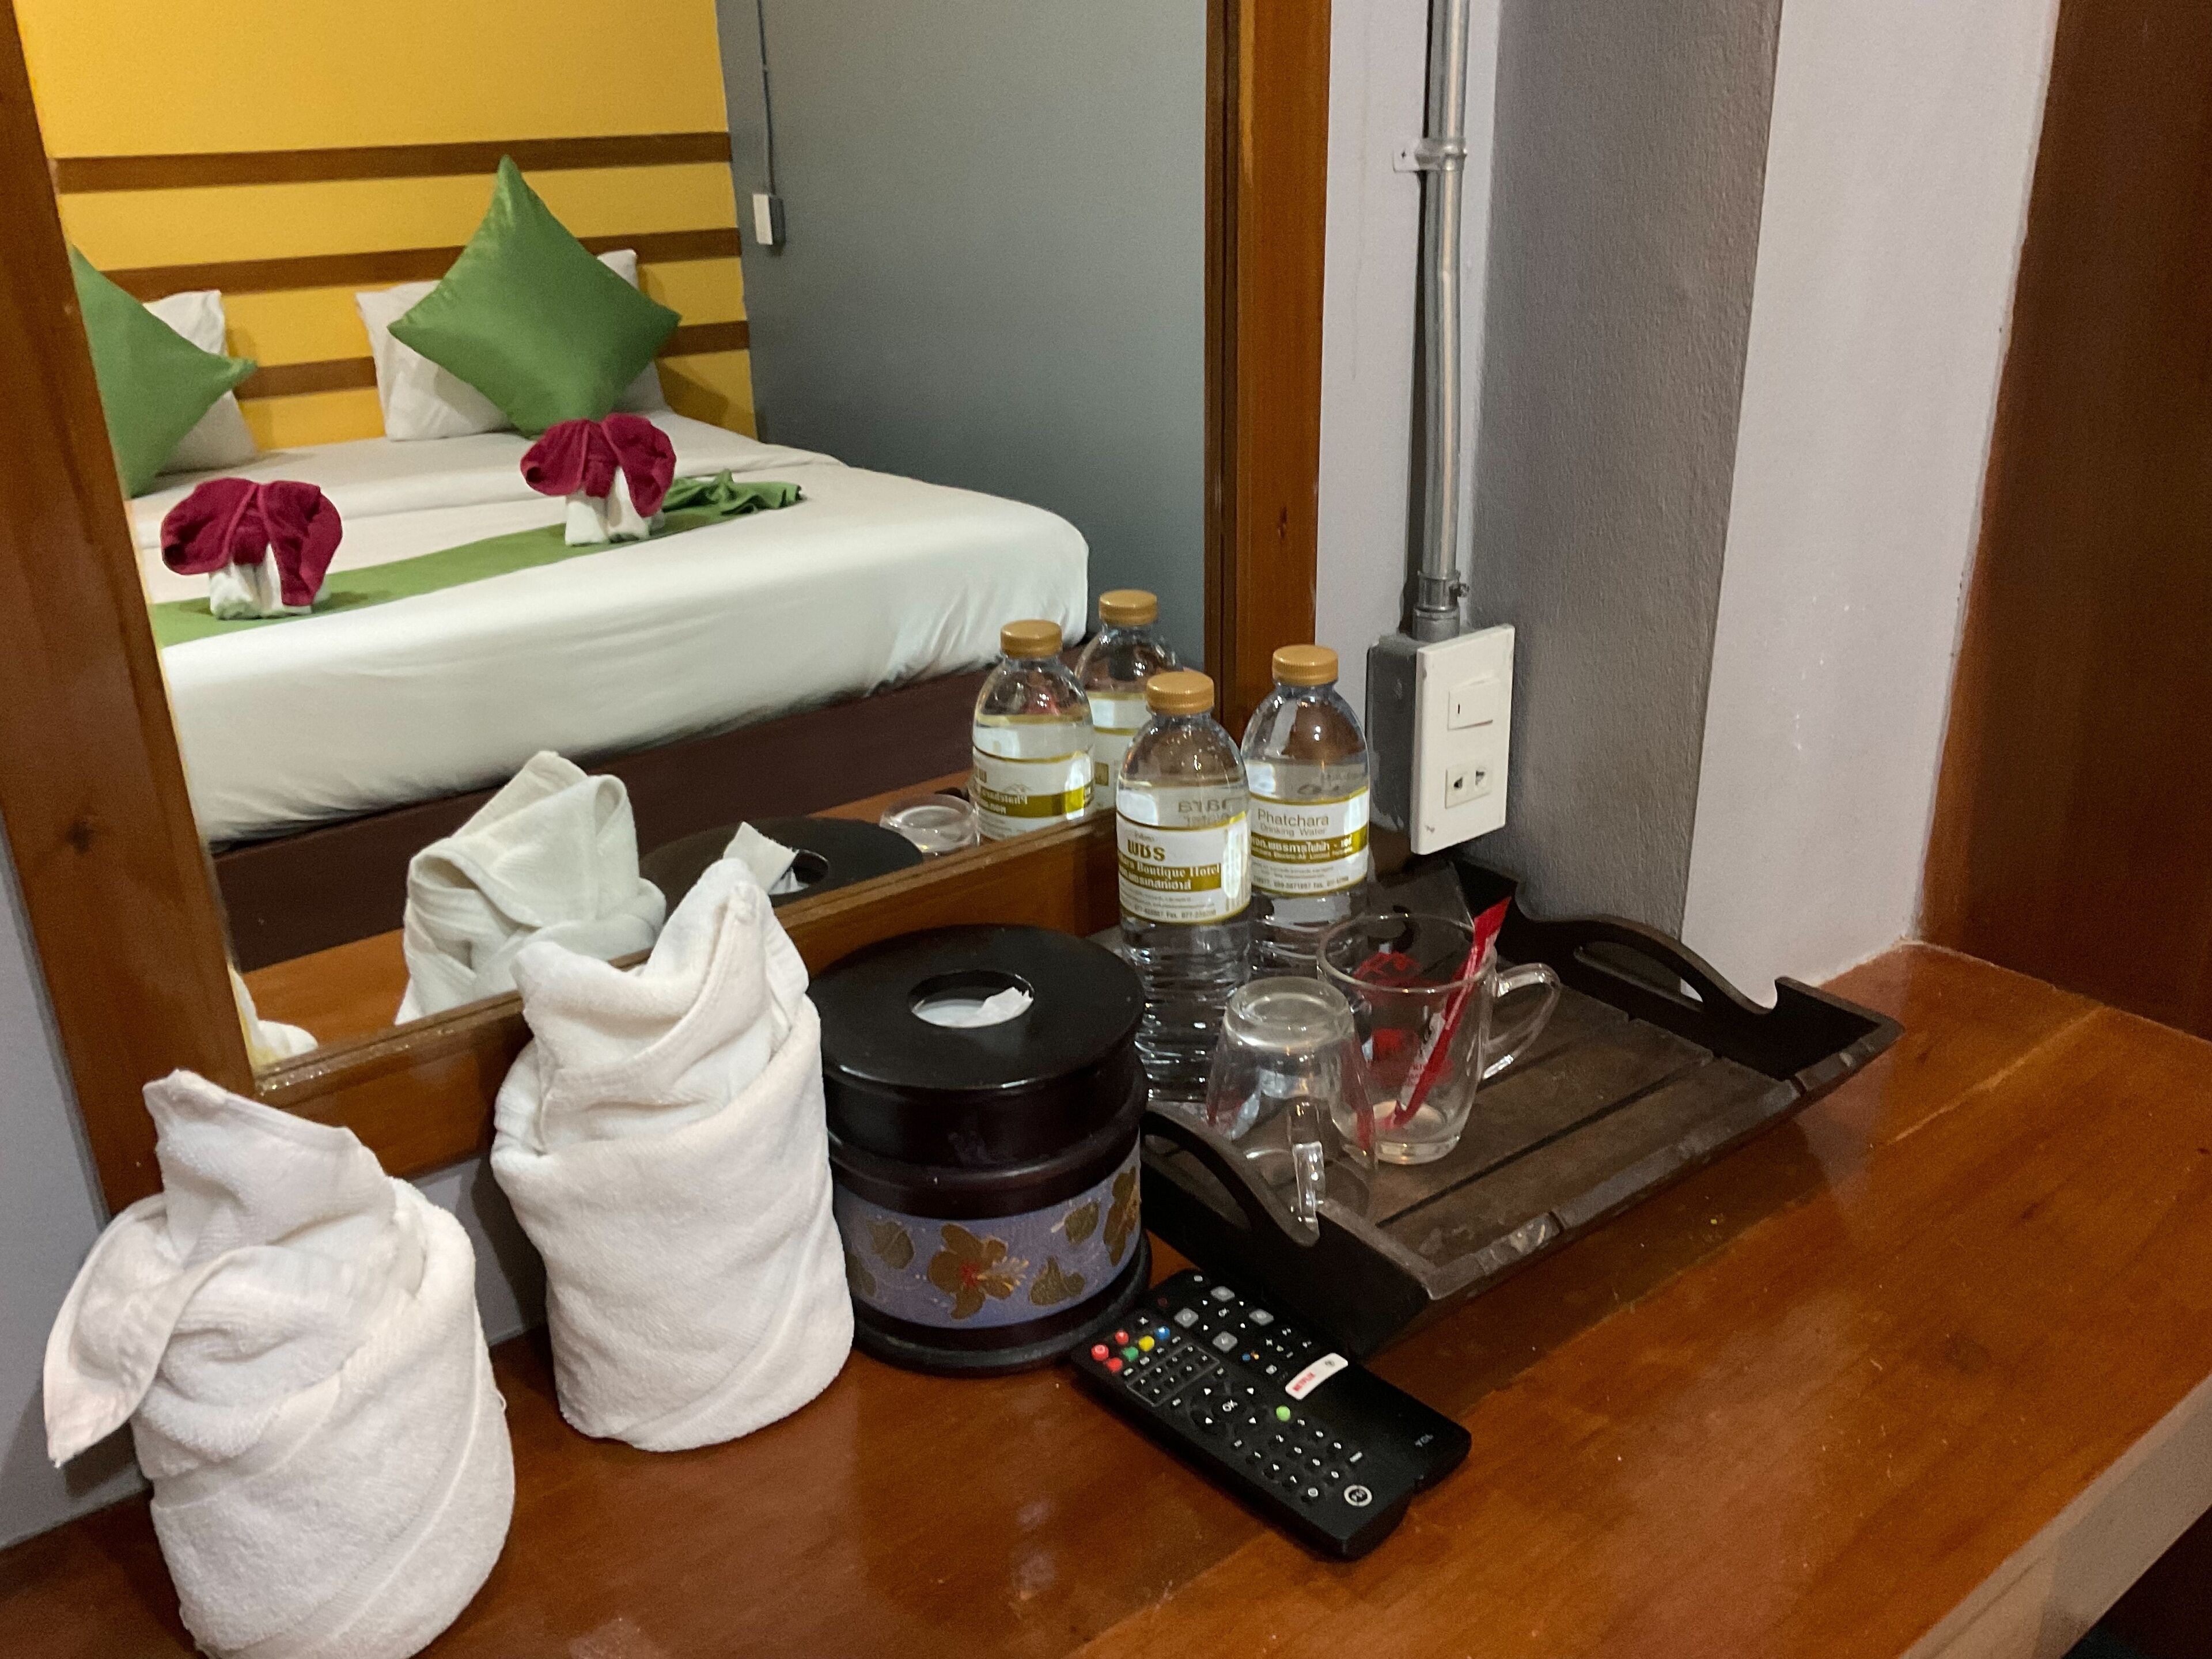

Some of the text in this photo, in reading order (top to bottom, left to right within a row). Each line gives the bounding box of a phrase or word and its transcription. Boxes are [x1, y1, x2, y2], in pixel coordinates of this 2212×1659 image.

[1257, 808, 1330, 827] Phatchara
[1299, 827, 1327, 836] Water
[1137, 861, 1185, 880] Boutique
[1190, 863, 1220, 877] Hotel
